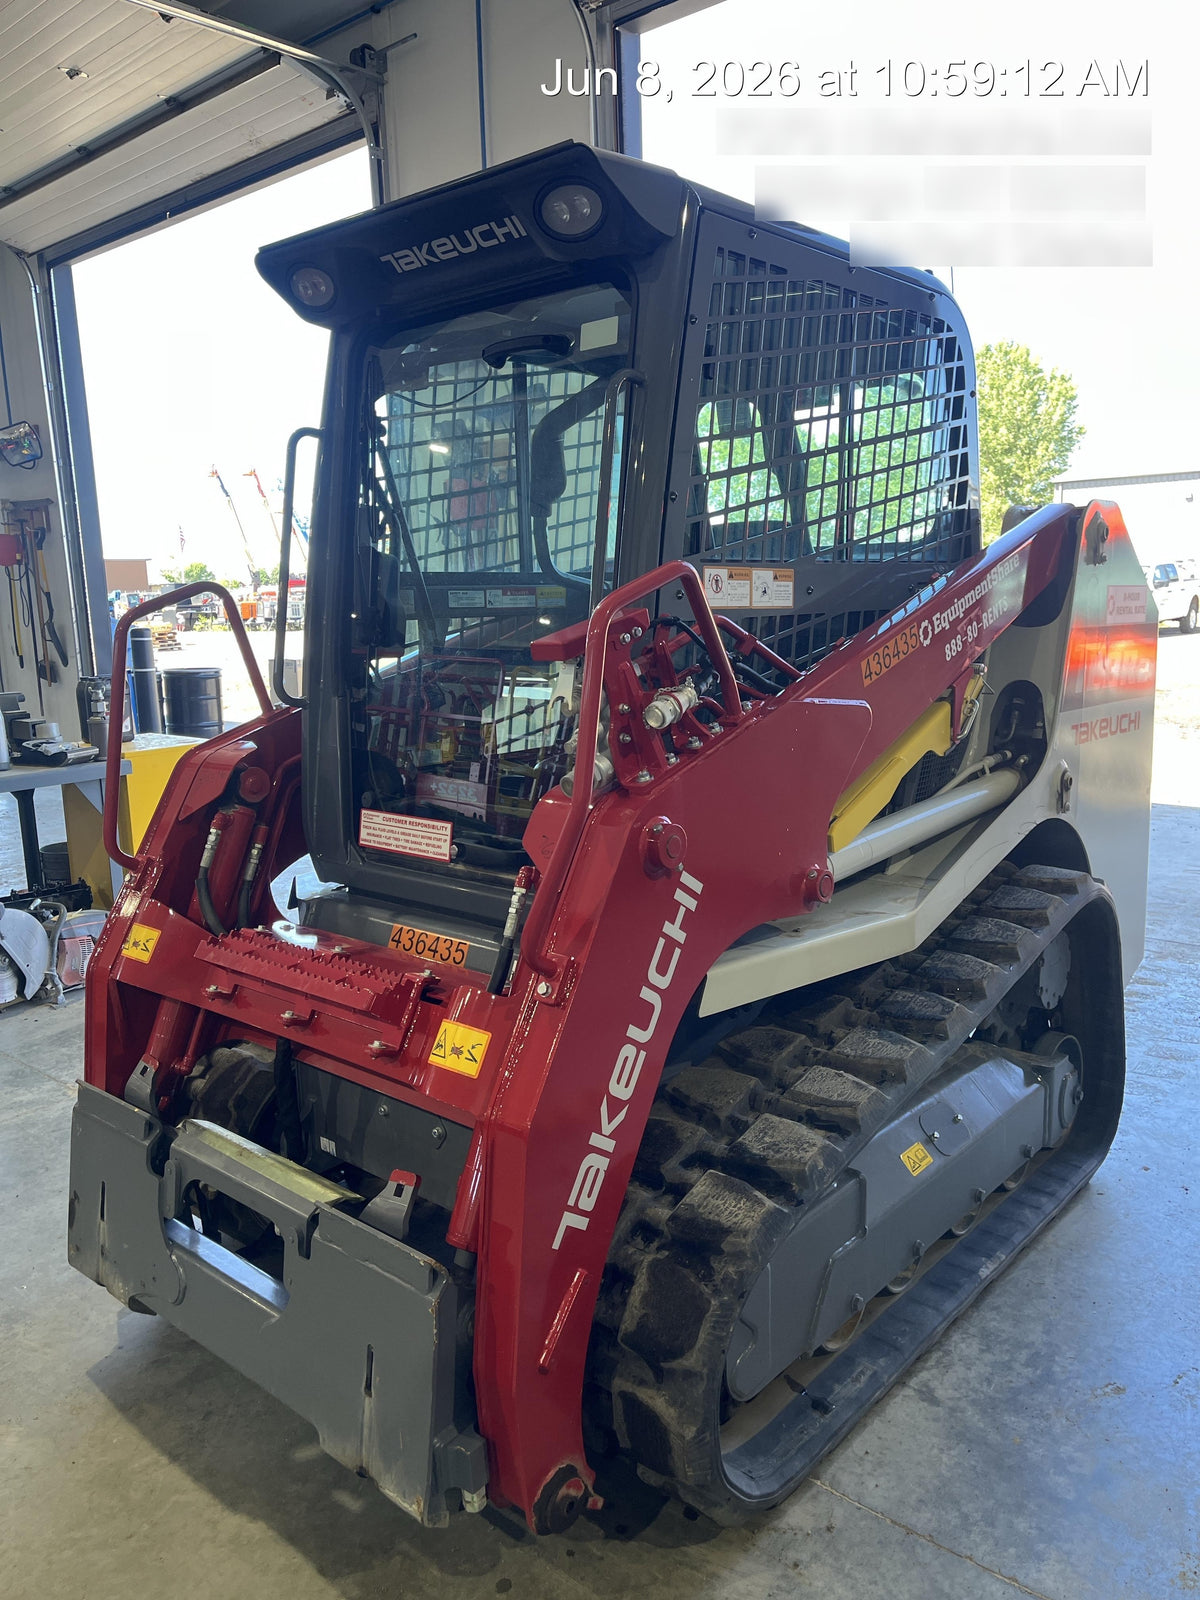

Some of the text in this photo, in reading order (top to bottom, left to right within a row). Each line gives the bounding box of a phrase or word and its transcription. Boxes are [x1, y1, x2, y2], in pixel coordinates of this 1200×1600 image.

[931, 554, 1020, 635] EquipmentShare
[863, 624, 919, 682] 436435
[944, 597, 1008, 662] 888-80-RENTS
[382, 816, 407, 825] CUSTOMER
[408, 820, 447, 832] RESPONSIBILITY
[390, 926, 468, 965] 436435
